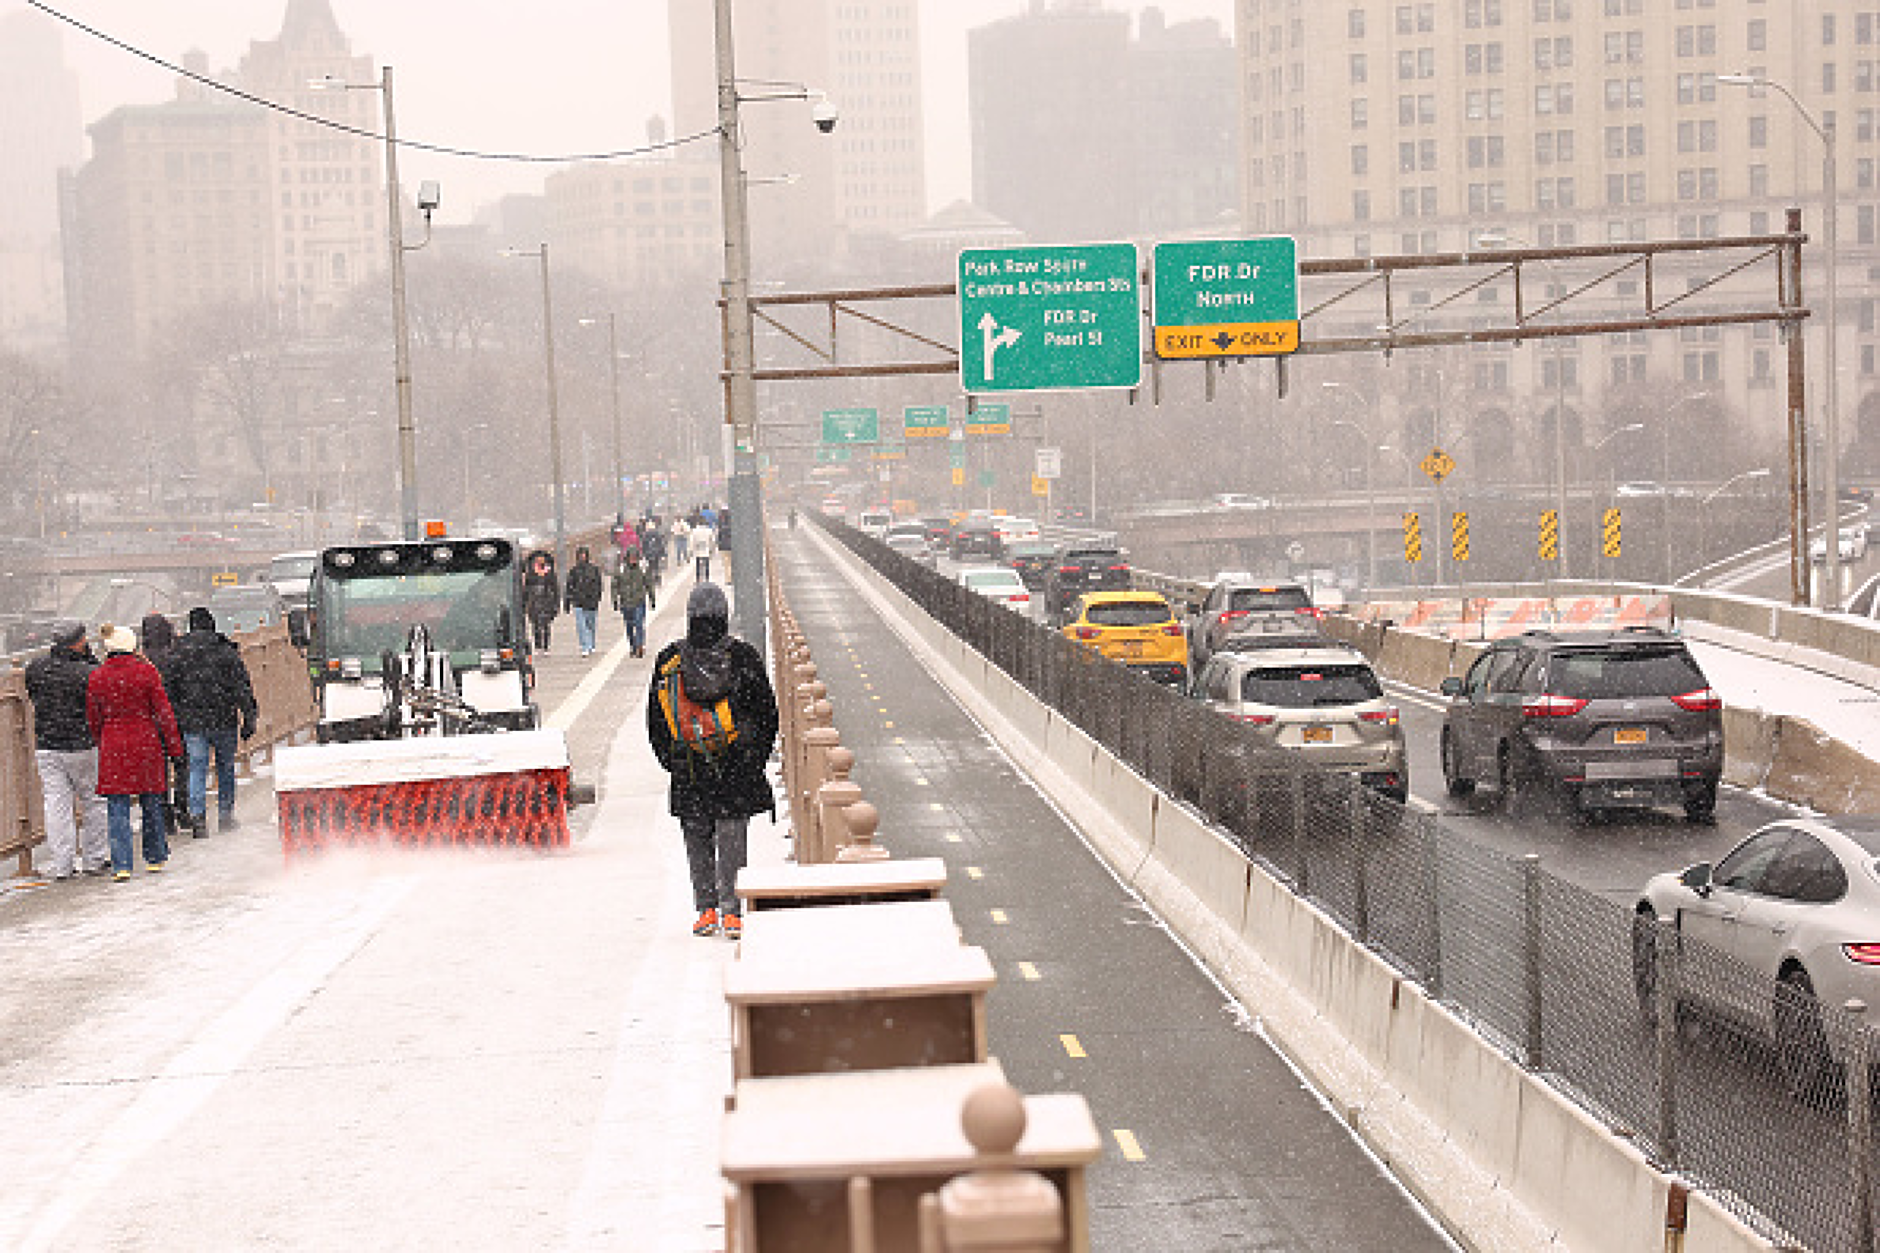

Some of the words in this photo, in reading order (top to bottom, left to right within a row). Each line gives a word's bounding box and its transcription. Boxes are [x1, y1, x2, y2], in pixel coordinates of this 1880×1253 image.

[965, 261, 1000, 275] Park
[1004, 259, 1038, 273] Row
[1188, 265, 1230, 282] FDR
[1238, 263, 1261, 279] Dr
[1018, 281, 1029, 295] &
[1044, 310, 1075, 325] FDR
[1079, 310, 1099, 324] Dr
[1165, 335, 1203, 349] EXIT
[1240, 331, 1288, 346] ONLY
